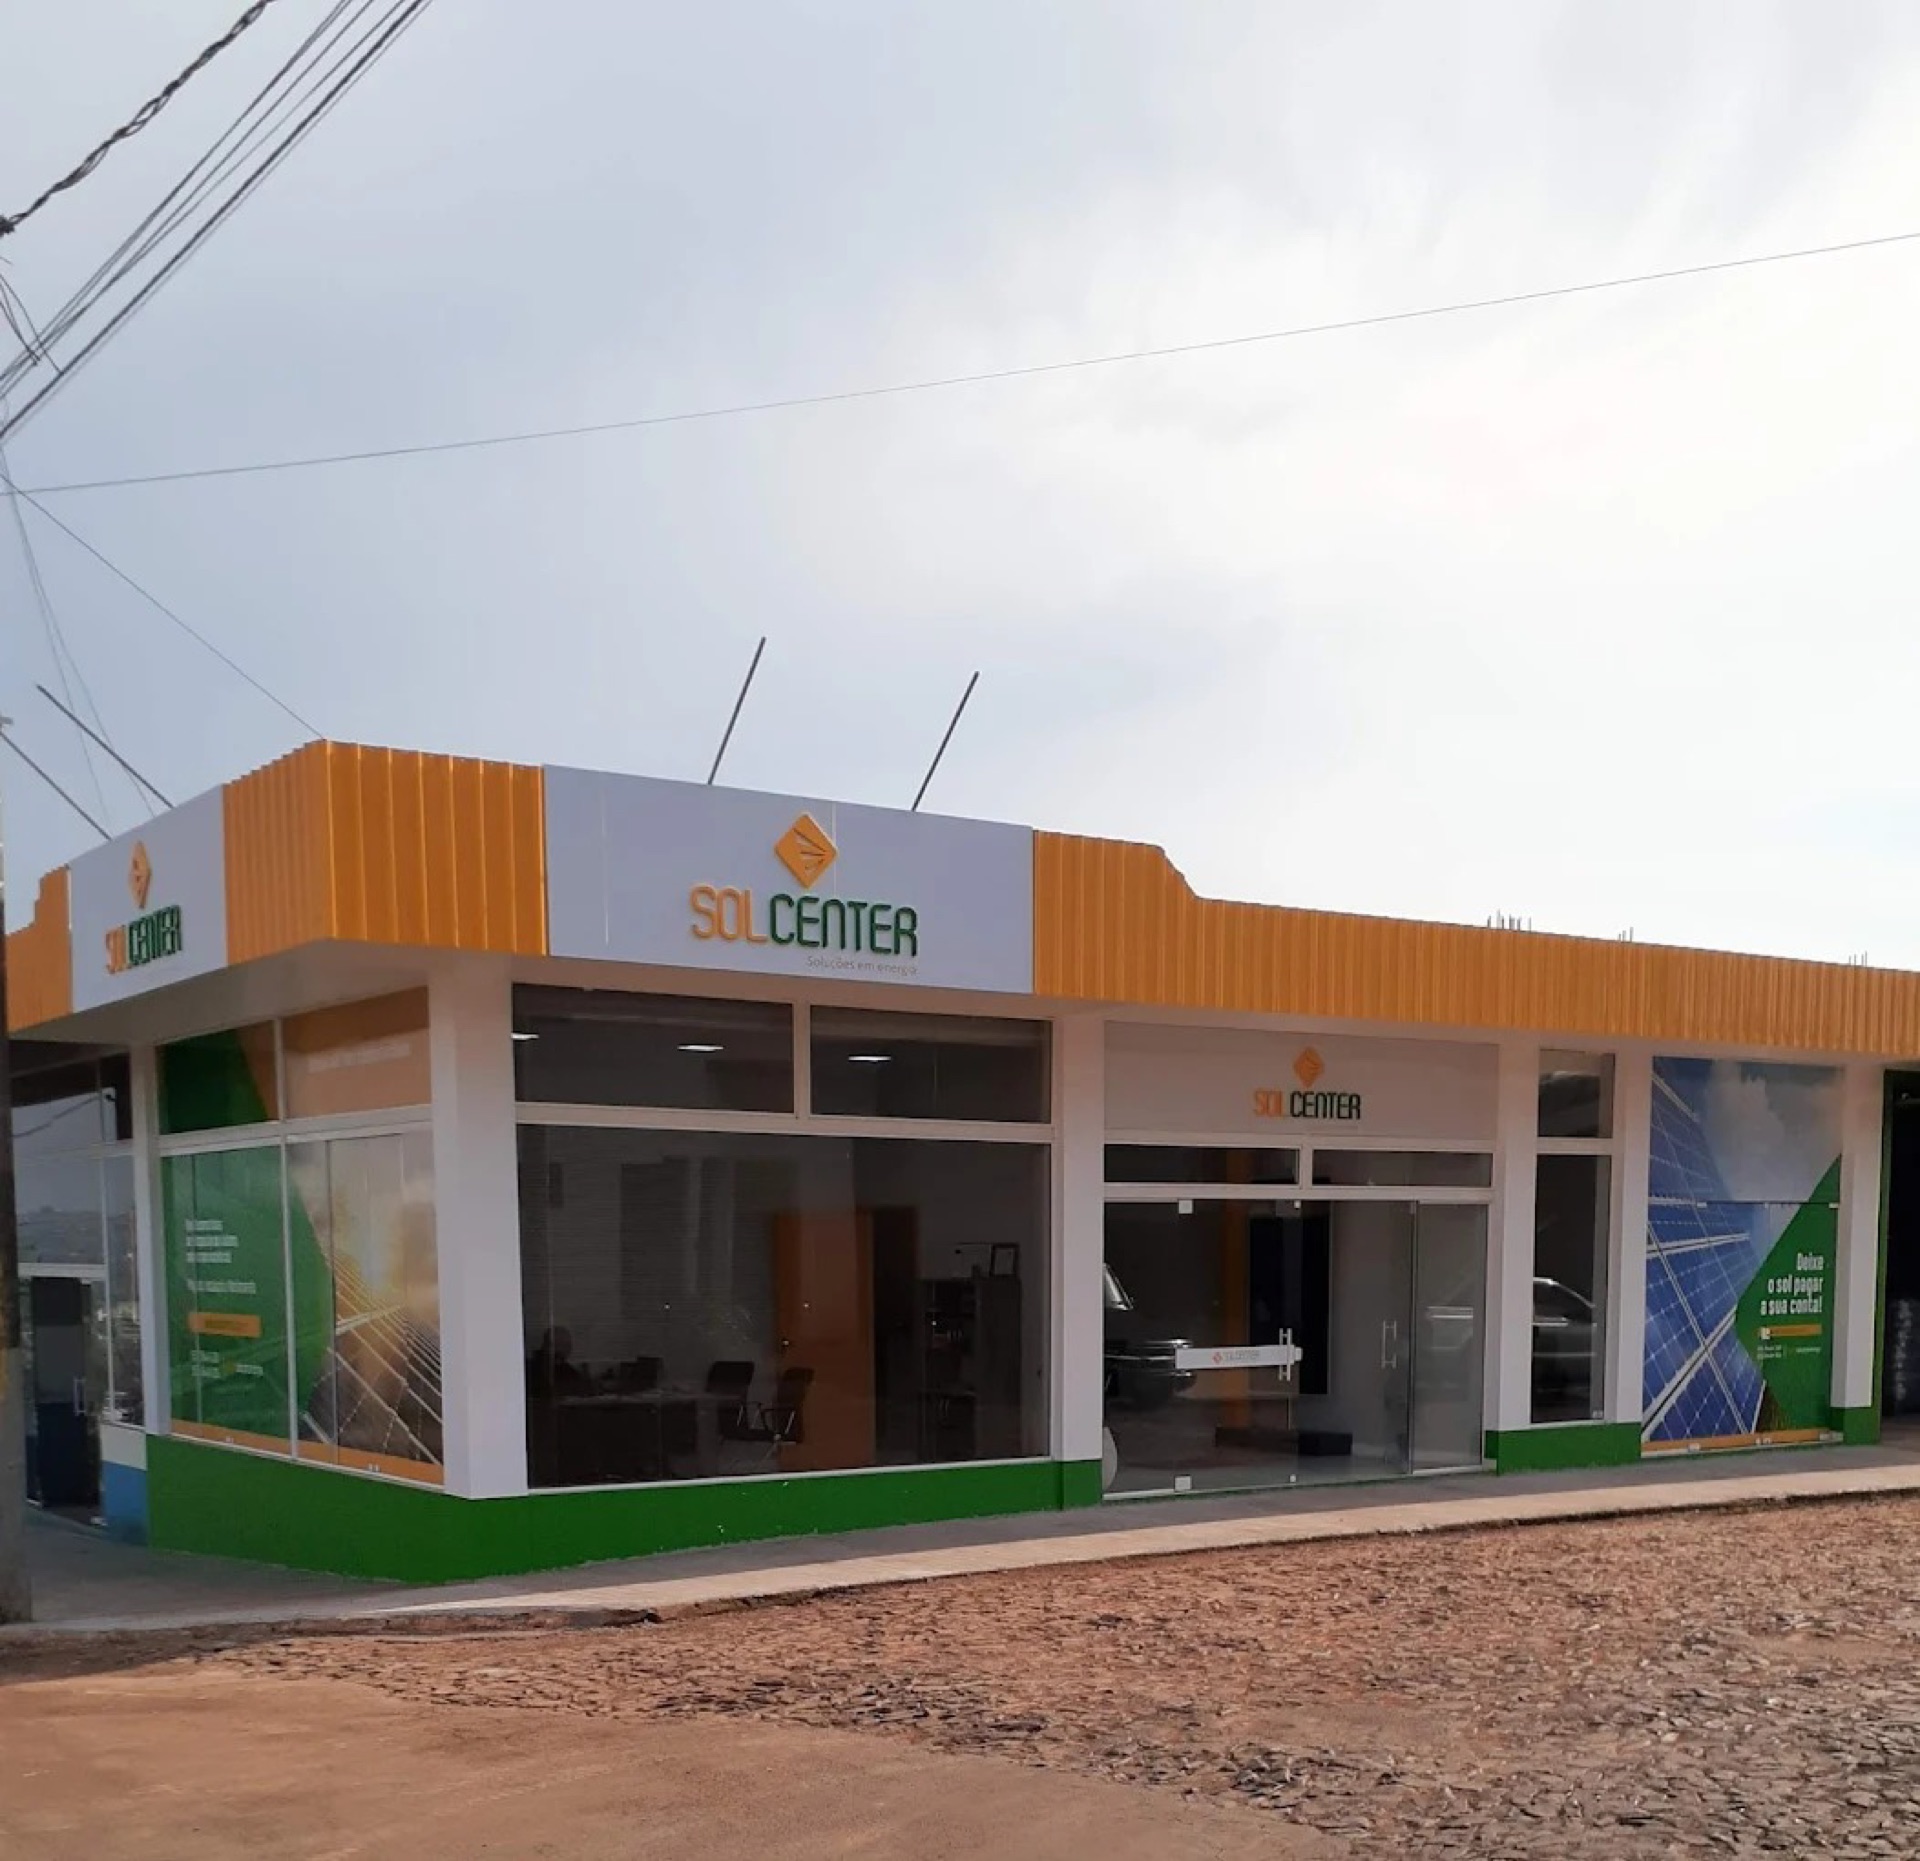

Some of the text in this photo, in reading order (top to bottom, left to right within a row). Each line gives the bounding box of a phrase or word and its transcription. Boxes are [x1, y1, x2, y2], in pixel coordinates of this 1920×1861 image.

[807, 956, 917, 977] Soluções em energia
[1797, 1251, 1824, 1271] Deixe
[1767, 1273, 1823, 1297] o sol pagar
[1760, 1294, 1823, 1316] a sua conta!
